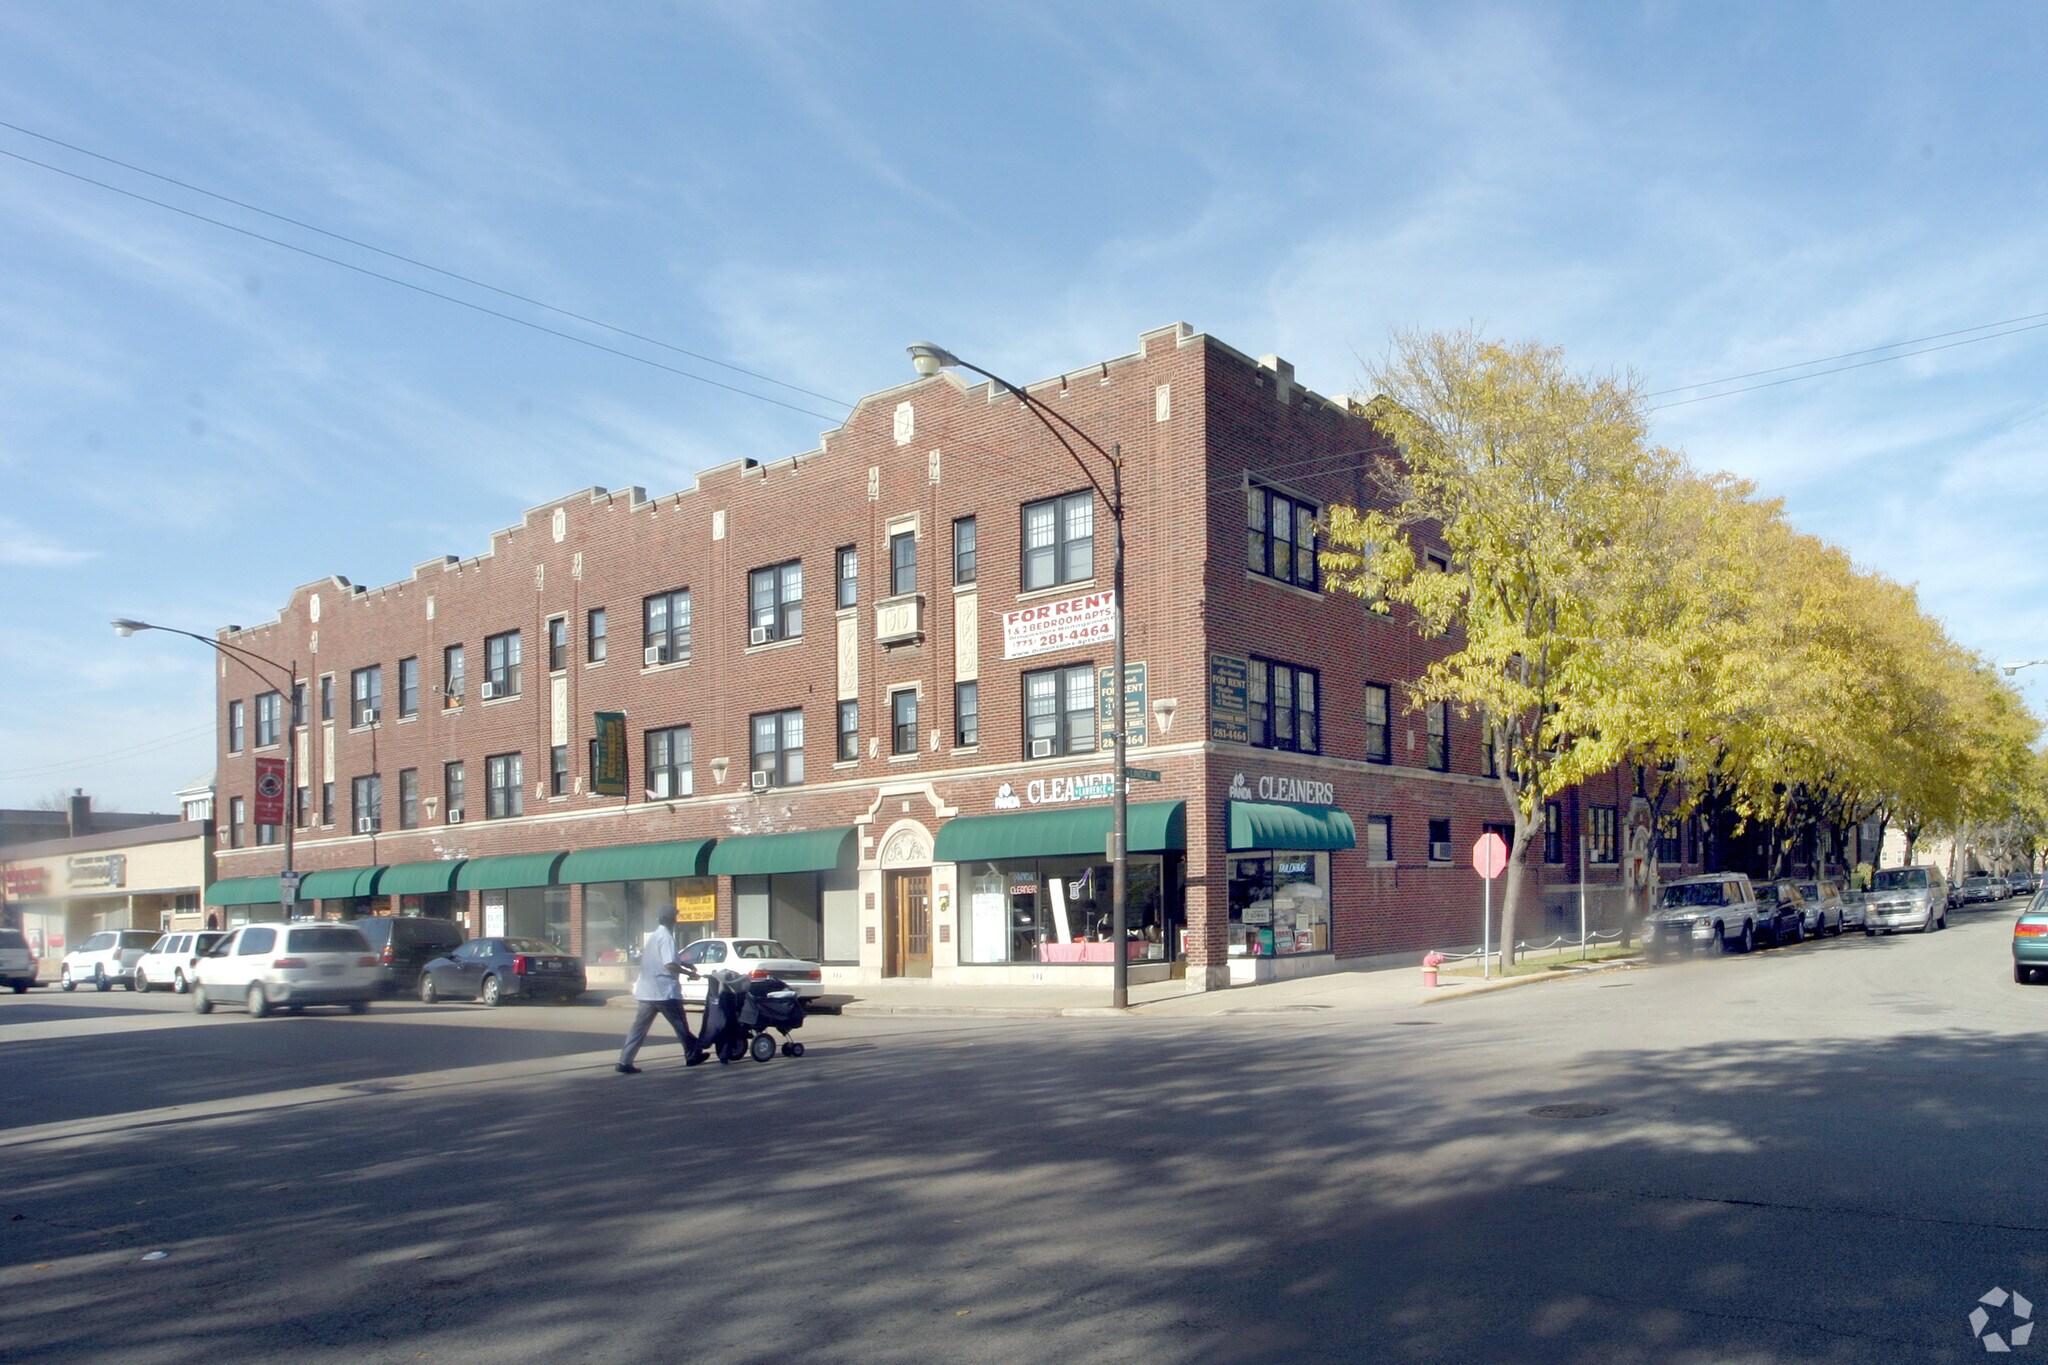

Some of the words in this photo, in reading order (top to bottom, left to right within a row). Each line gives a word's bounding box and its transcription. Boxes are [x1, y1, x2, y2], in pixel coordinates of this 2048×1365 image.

[1008, 606, 1050, 625] FOR
[1056, 592, 1113, 615] RENT
[1014, 627, 1019, 635] &
[1022, 625, 1027, 633] 2
[1029, 614, 1082, 631] BEDROOM
[1040, 623, 1109, 646] 281-4464
[1124, 683, 1143, 693] ENT
[1212, 675, 1226, 685] FOR
[1228, 678, 1246, 688] RENT
[1080, 785, 1106, 797] LAWRENCE
[1229, 785, 1252, 800] PANDA
[1259, 776, 1334, 805] CLEANERS
